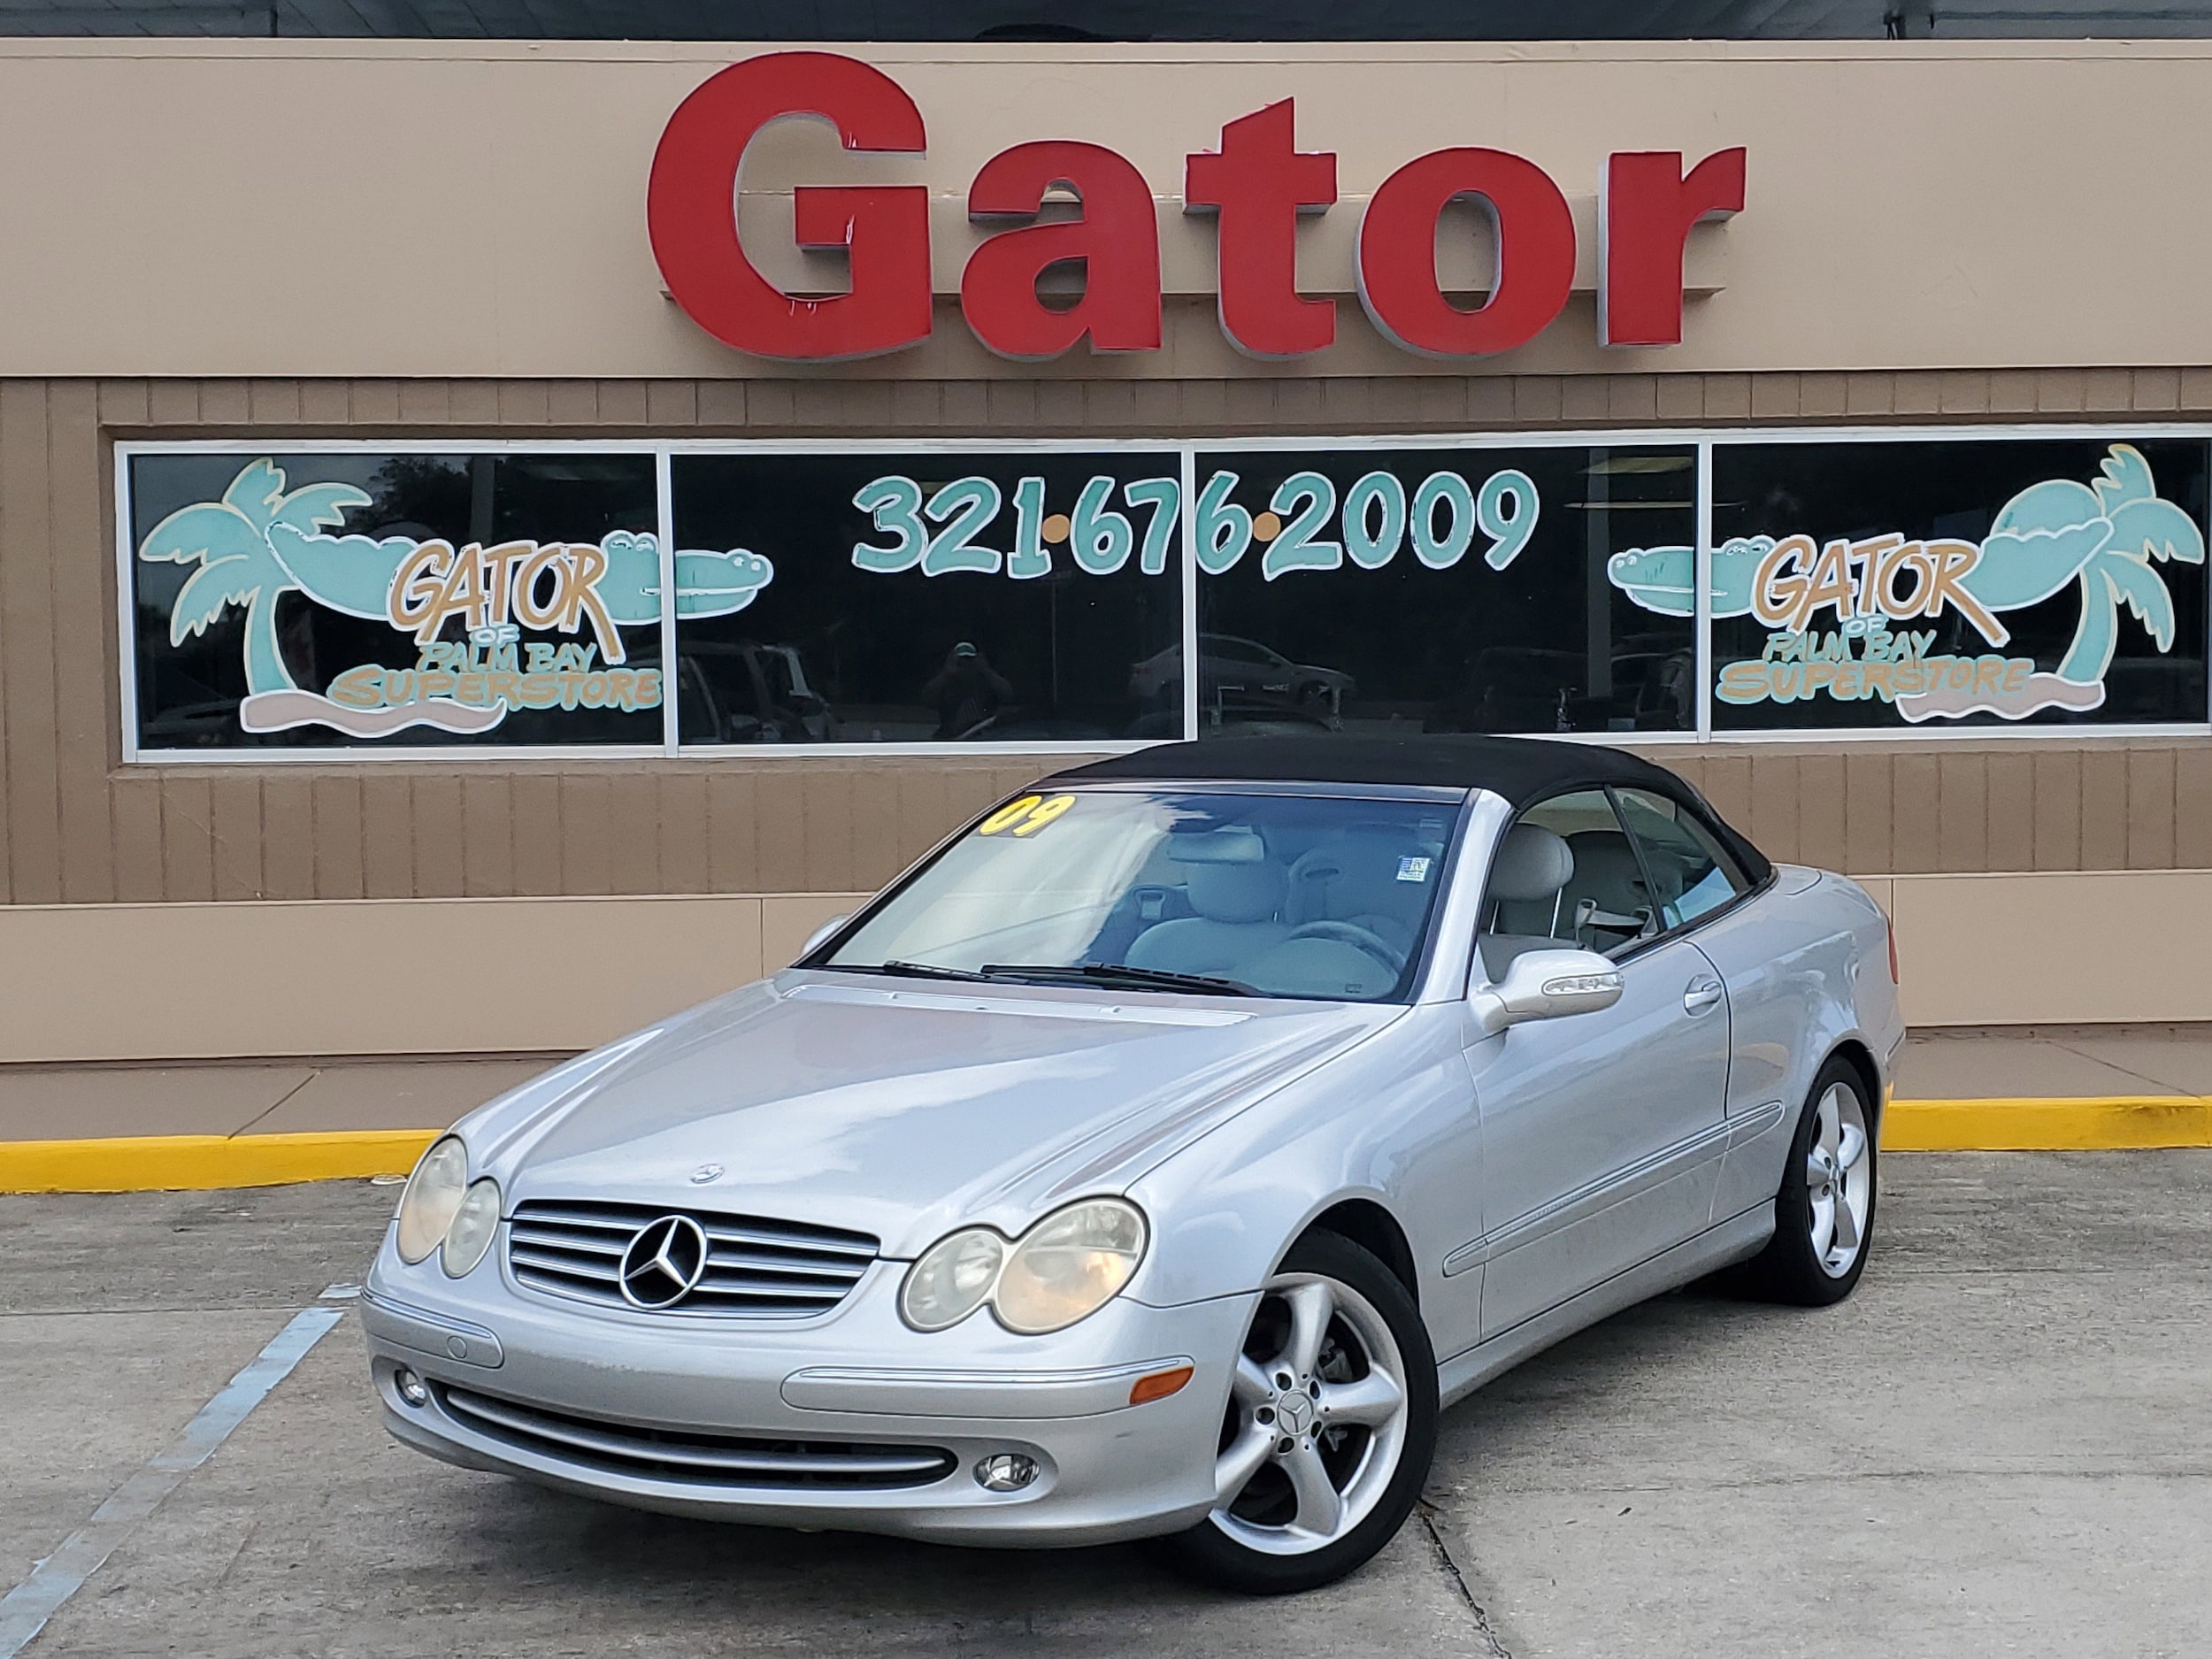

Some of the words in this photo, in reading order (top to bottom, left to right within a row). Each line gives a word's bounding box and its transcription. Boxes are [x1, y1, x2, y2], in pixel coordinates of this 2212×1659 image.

[648, 50, 1747, 361] Gator
[387, 540, 626, 664] GATOR
[1752, 533, 2010, 648] GATOR
[470, 625, 519, 646] OF
[1762, 631, 1852, 663] PALM
[1862, 629, 1937, 663] BAY
[1842, 617, 1888, 637] OF
[417, 641, 518, 672] PALM
[525, 642, 597, 672] BAY
[326, 664, 663, 712] SUPERSTORE
[1715, 654, 2035, 704] SUPERSTORE
[979, 795, 1076, 836] 09
